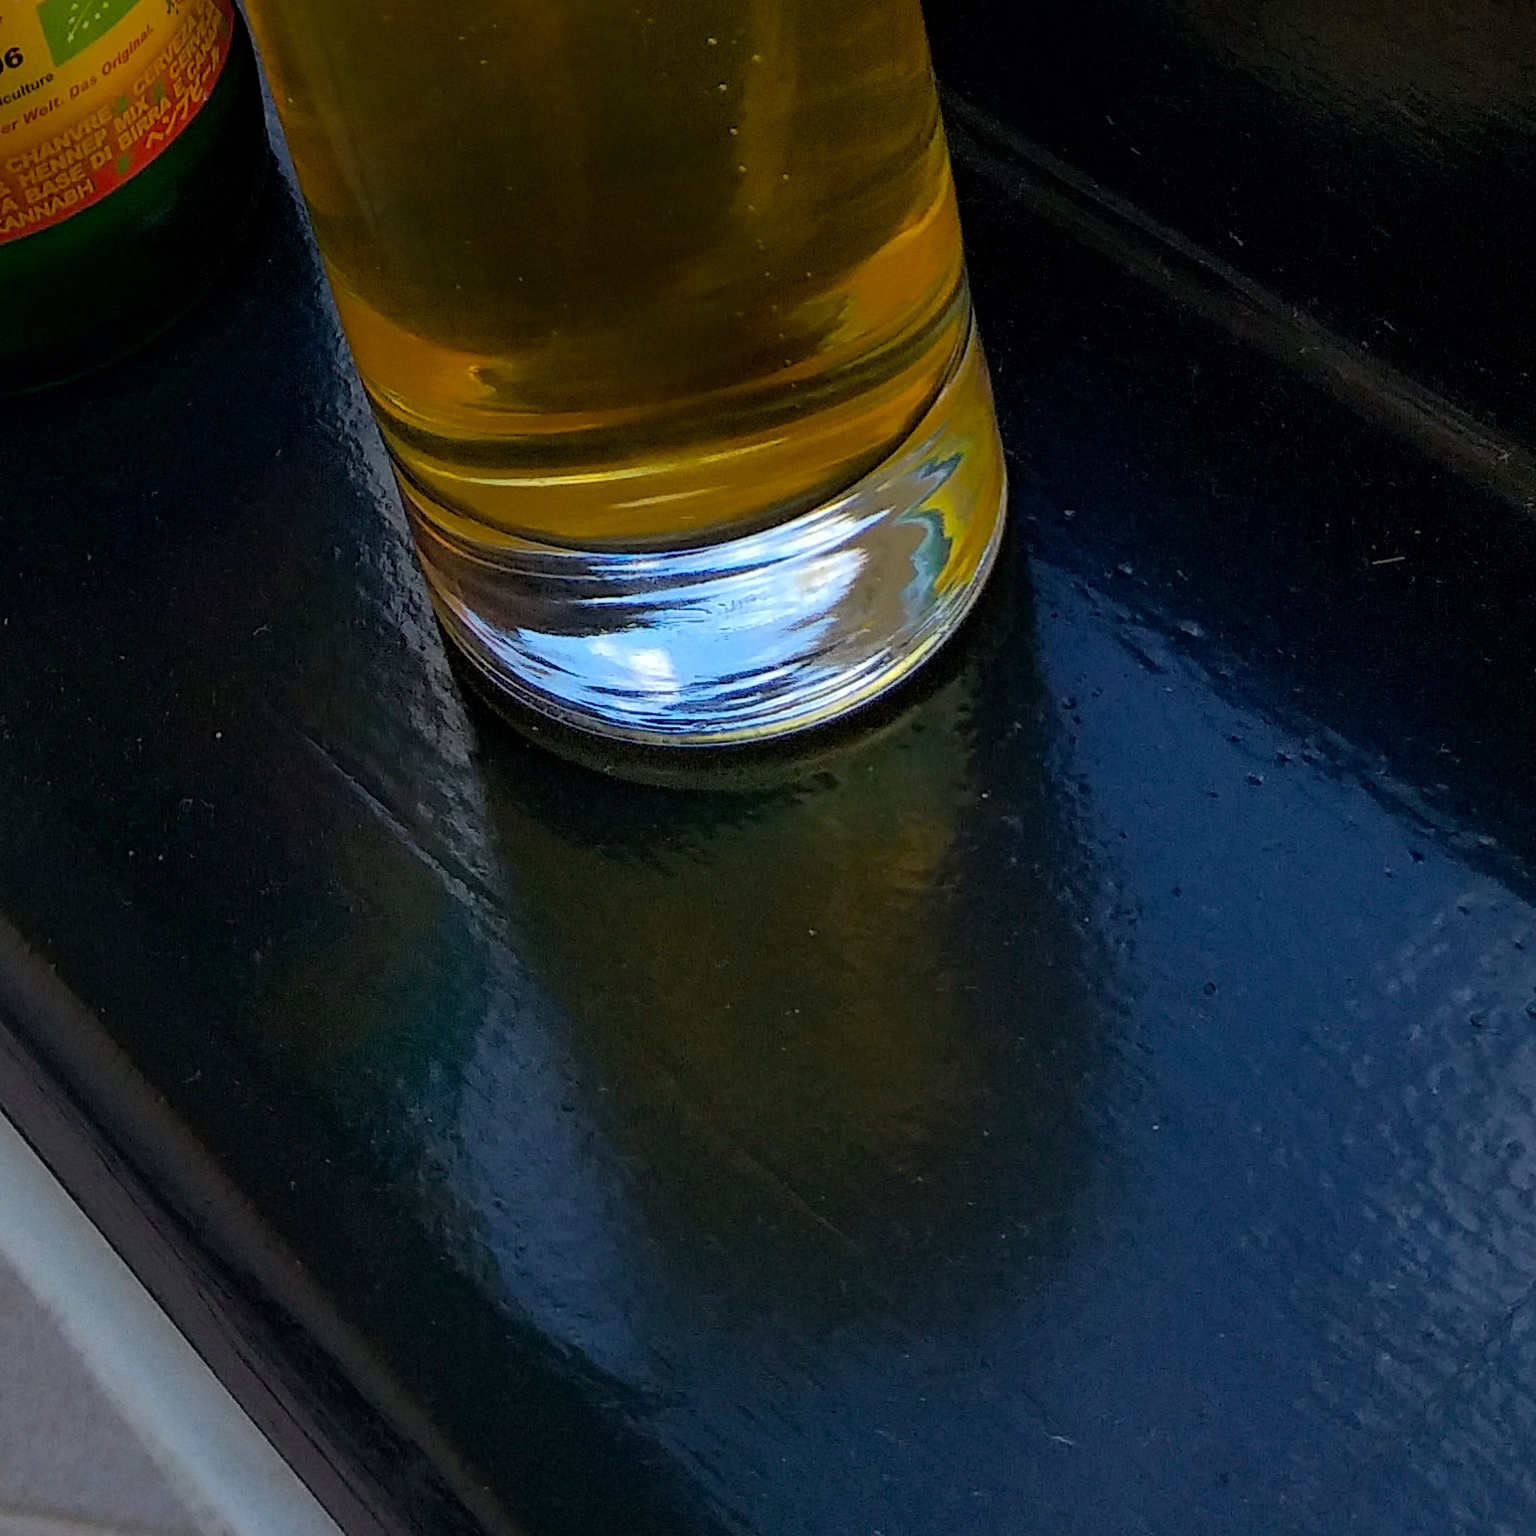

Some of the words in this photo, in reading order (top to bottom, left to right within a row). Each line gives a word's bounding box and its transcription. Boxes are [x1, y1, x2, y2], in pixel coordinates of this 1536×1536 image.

[69, 75, 98, 100] Das
[114, 94, 151, 131] MIX
[23, 166, 85, 204] BASE
[89, 146, 114, 170] DI
